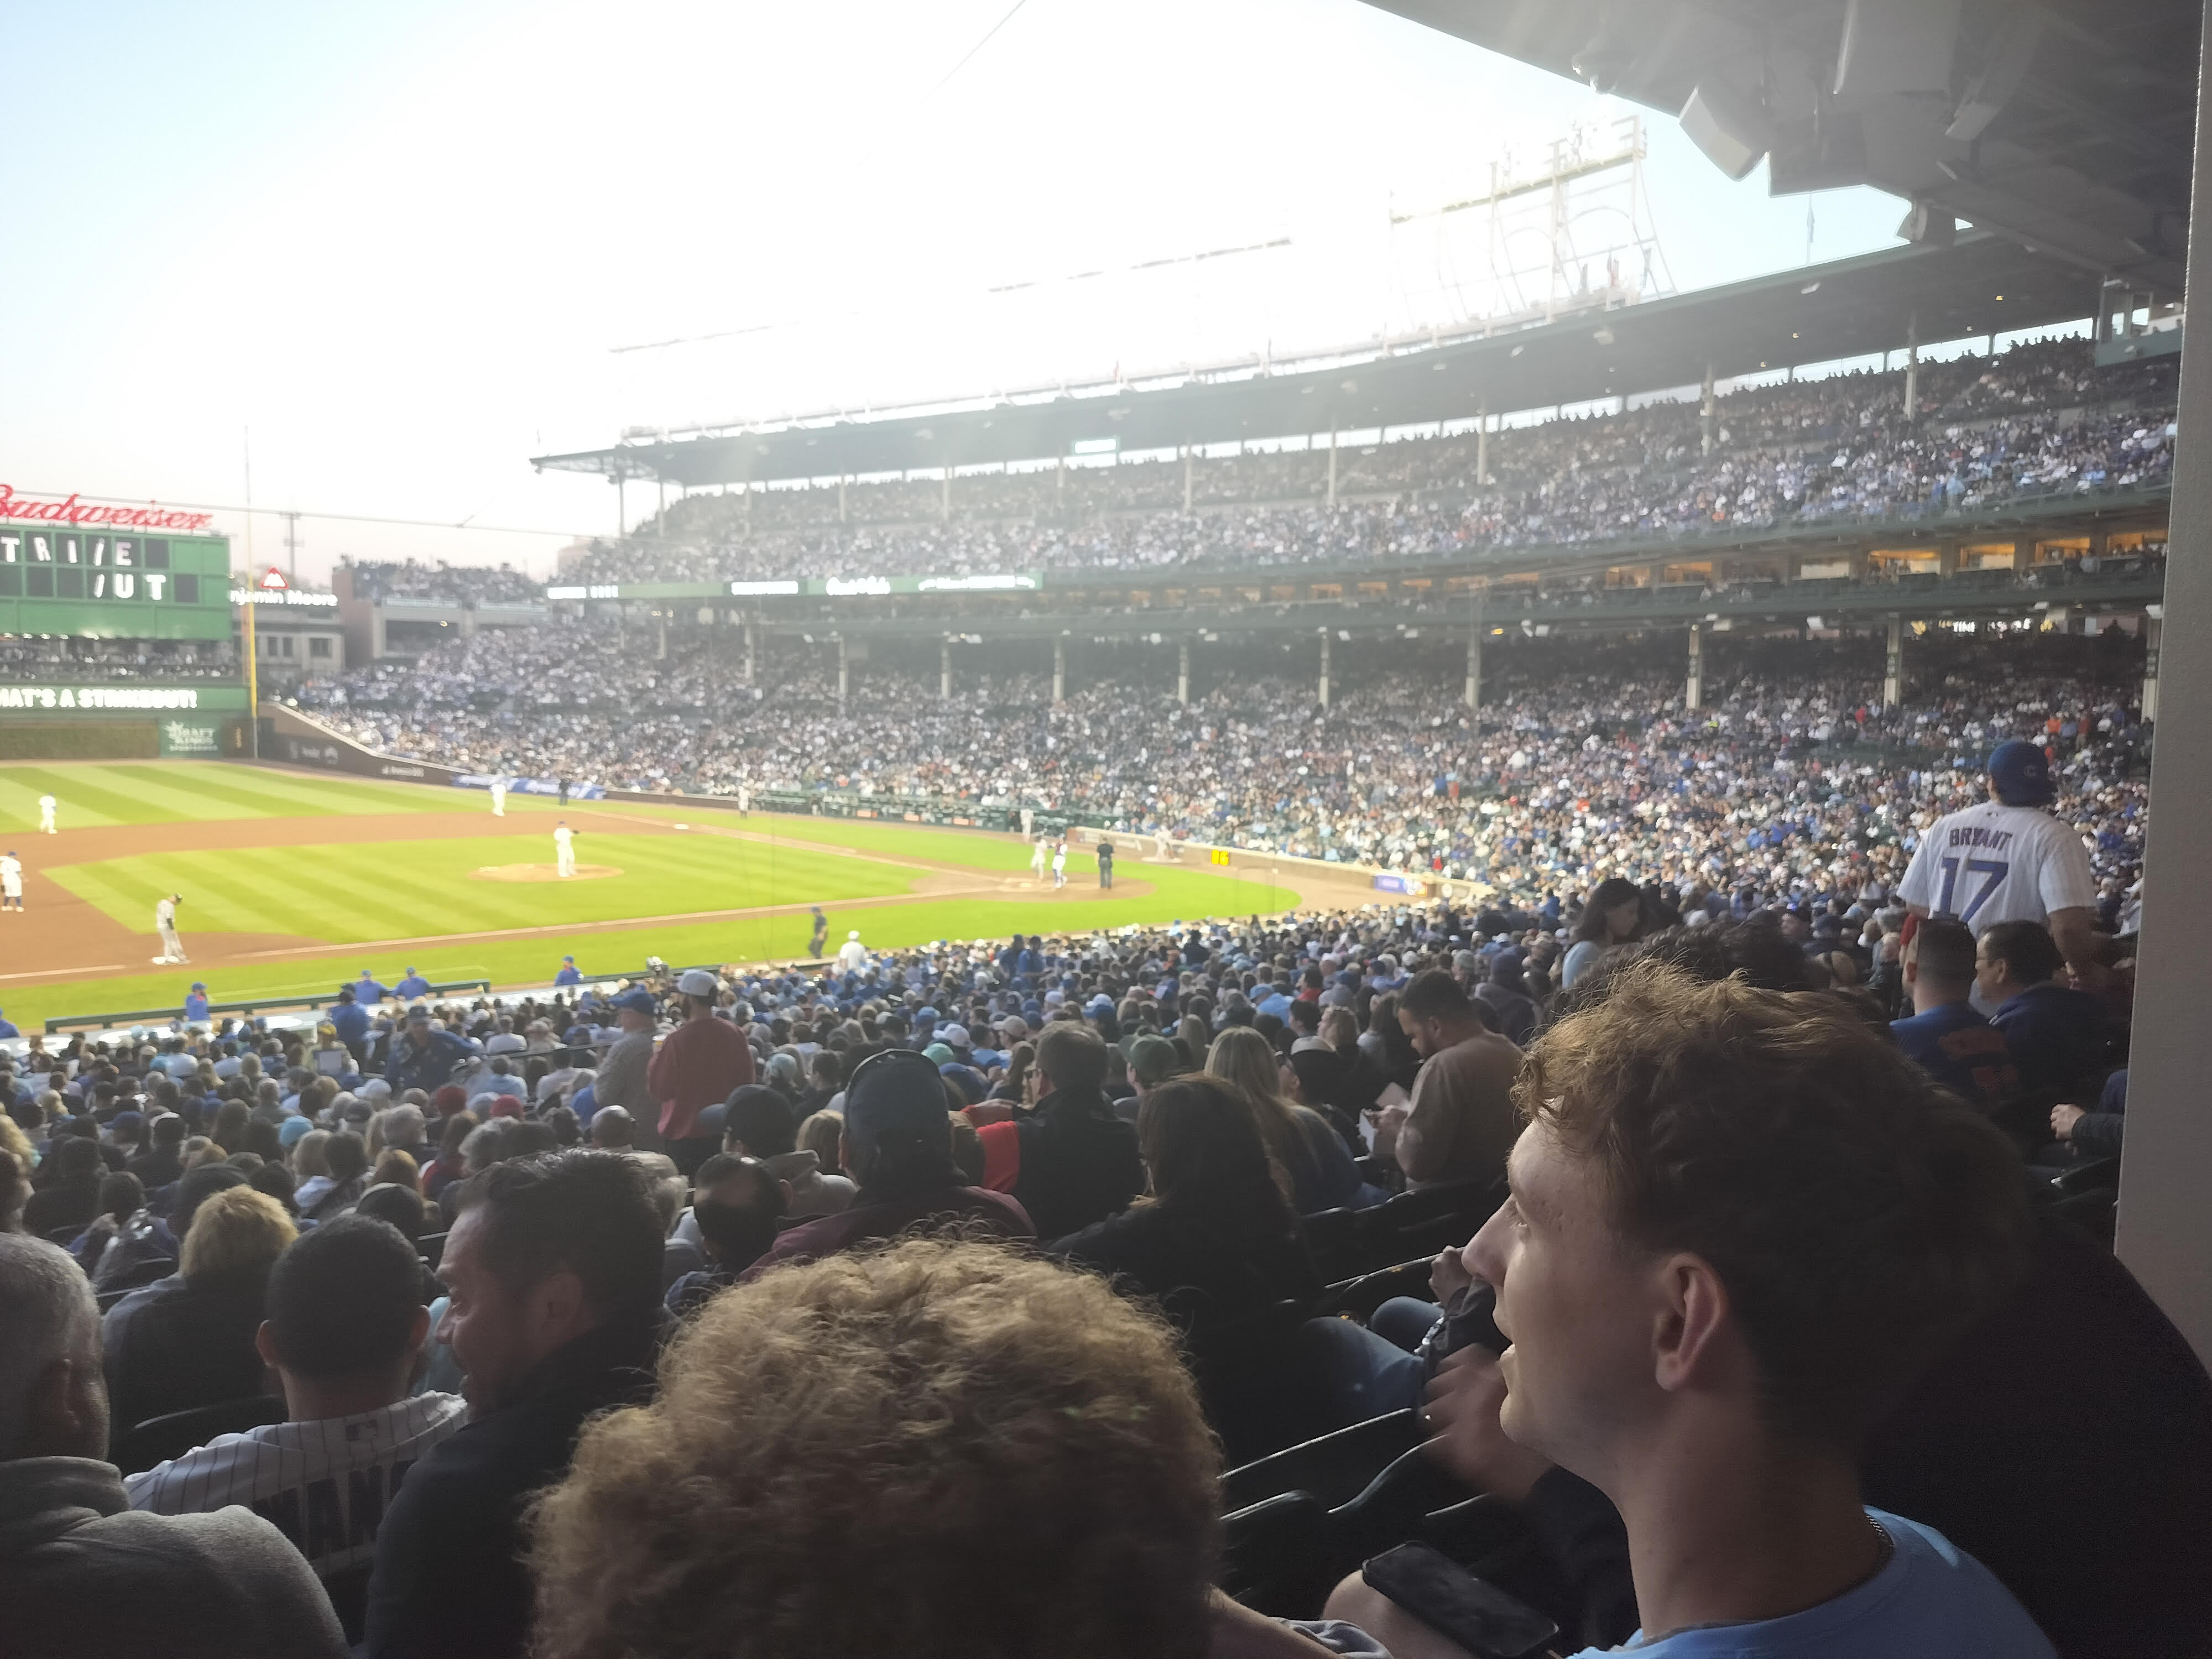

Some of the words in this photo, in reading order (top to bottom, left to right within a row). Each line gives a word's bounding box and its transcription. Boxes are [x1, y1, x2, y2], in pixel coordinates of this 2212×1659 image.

[286, 589, 338, 607] Moore
[59, 688, 76, 708] A
[1949, 827, 2013, 851] BRYANT
[1941, 857, 2008, 922] 17
